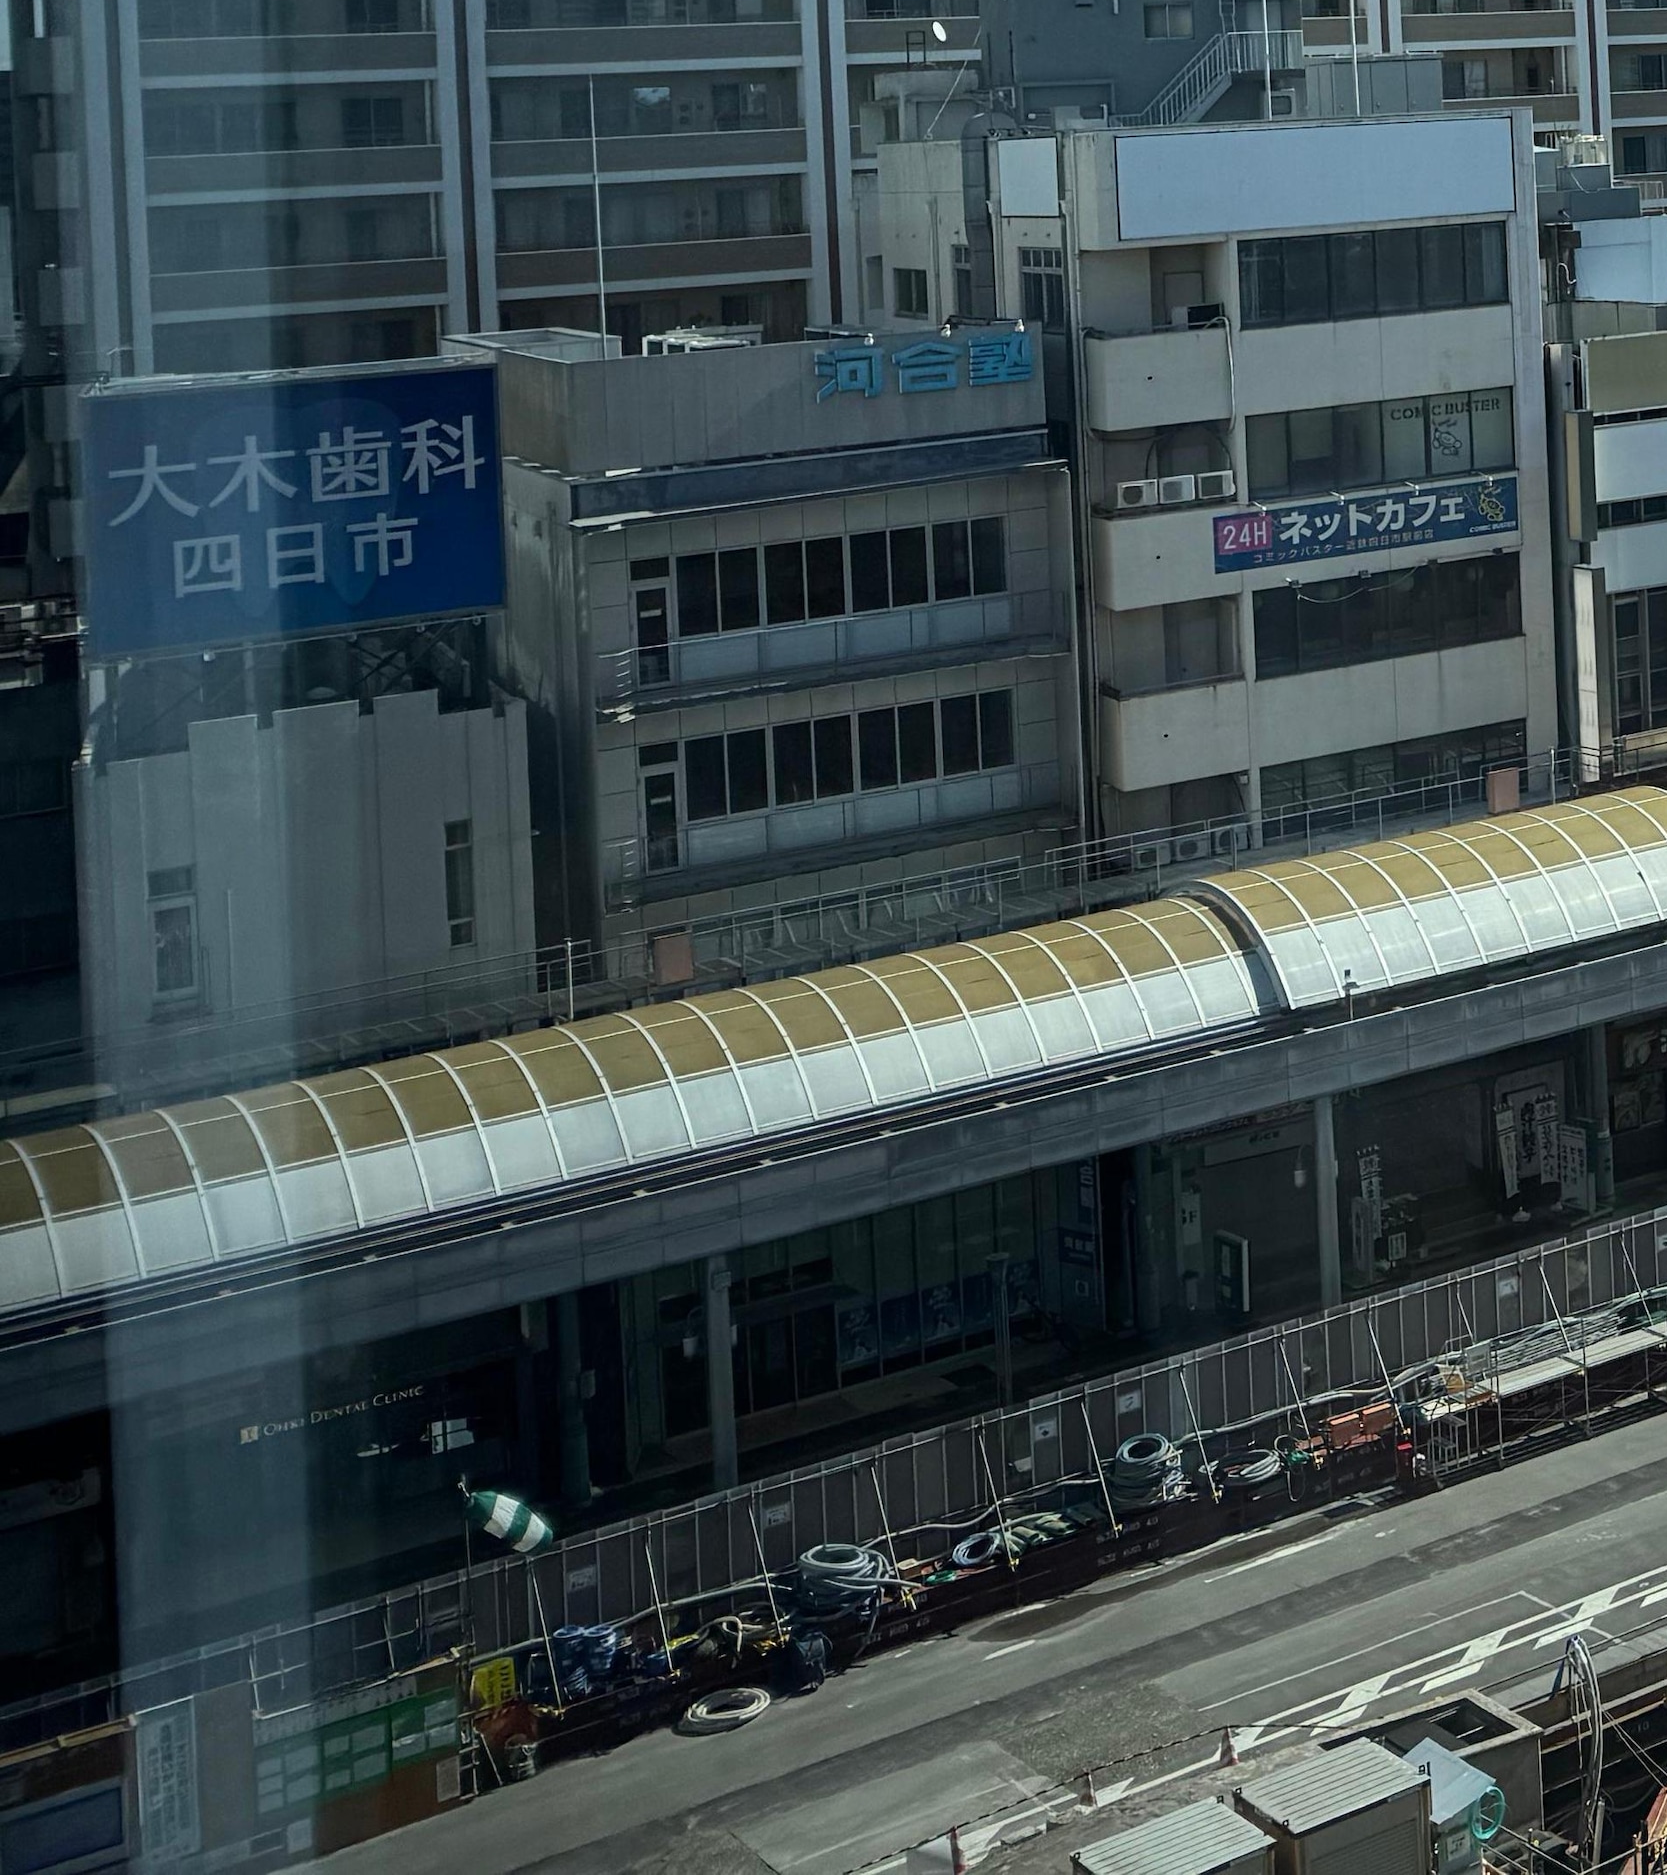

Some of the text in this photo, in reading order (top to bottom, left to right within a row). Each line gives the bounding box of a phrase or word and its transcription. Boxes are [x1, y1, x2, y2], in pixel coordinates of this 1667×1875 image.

[814, 332, 1032, 404] 河合塾
[108, 415, 486, 527] 大木歯科
[173, 512, 419, 598] 四日市
[1222, 494, 1466, 551] 24H ネットカフェ
